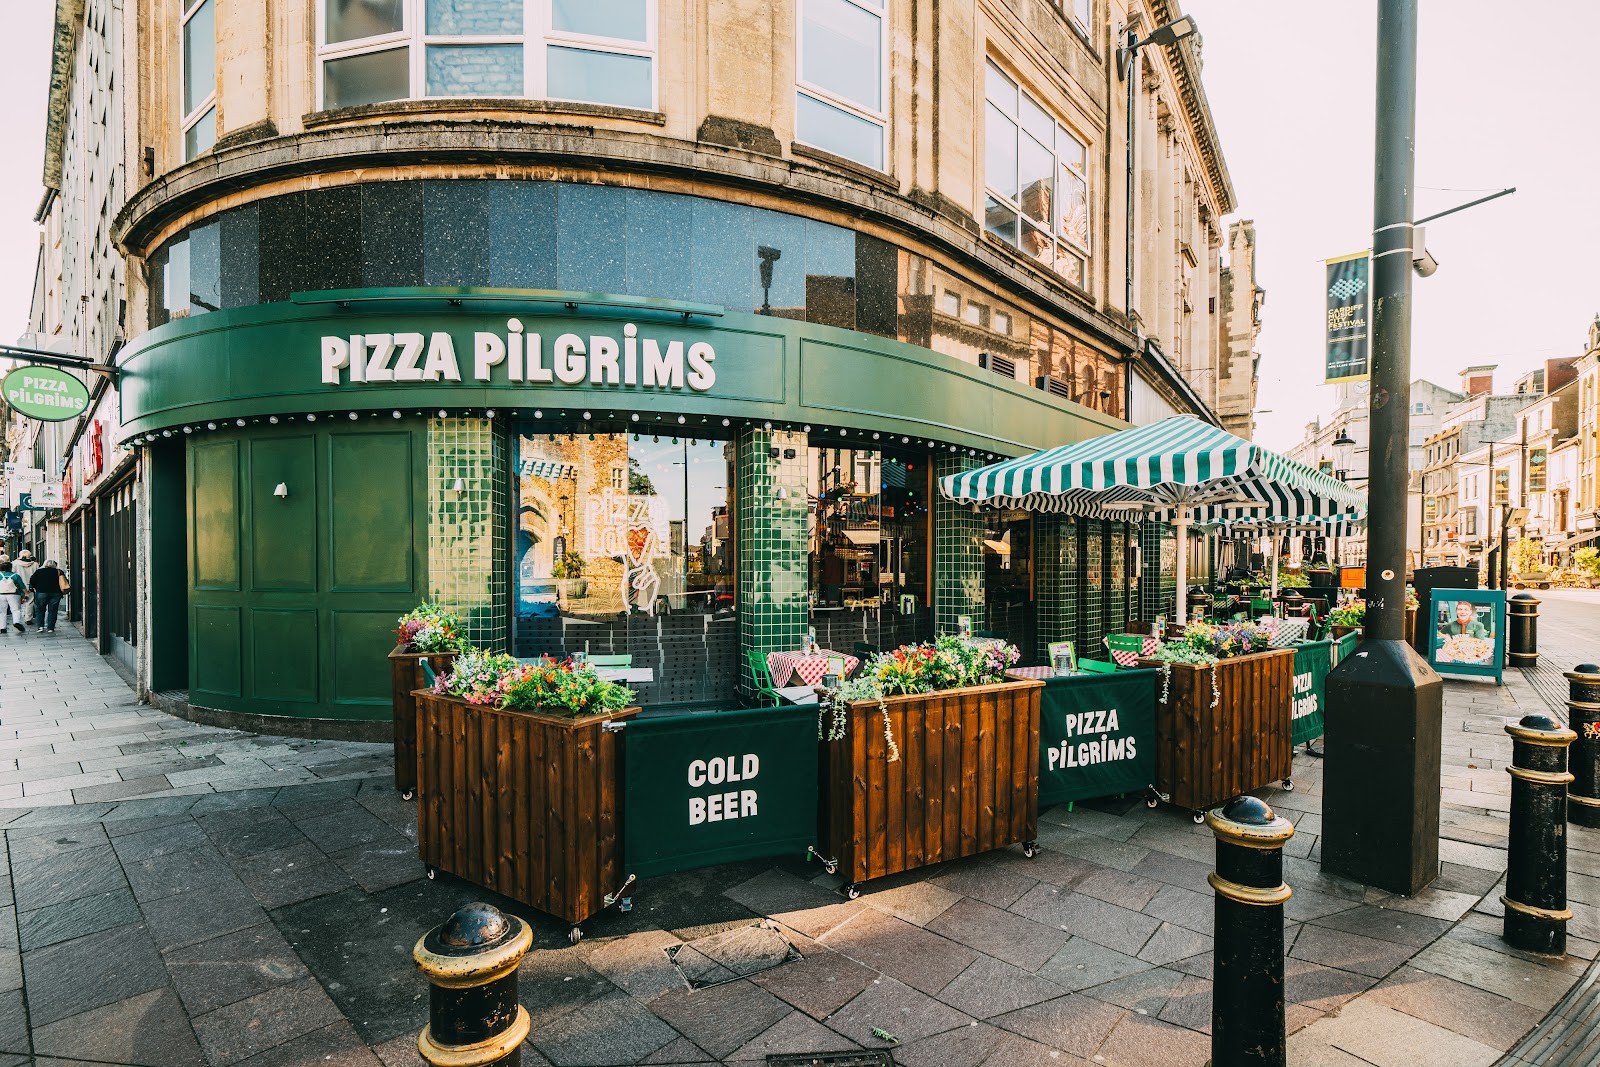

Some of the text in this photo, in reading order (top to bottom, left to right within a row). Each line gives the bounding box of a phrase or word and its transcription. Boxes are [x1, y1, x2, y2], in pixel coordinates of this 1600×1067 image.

[1328, 304, 1364, 315] CARDIFF
[1328, 311, 1353, 320] MUSIC
[1328, 319, 1366, 329] FESTIVAL
[321, 318, 716, 392] PIZZA PiLGRiMS
[23, 376, 68, 393] PIZZA
[9, 388, 84, 410] PiLGRiMS
[1293, 672, 1312, 695] PIZZA
[1291, 691, 1318, 720] iLGRiMS
[1066, 709, 1119, 737] PIZZA
[1047, 734, 1137, 771] PiLGRiMS
[688, 753, 760, 788] COLD
[688, 789, 758, 826] BEER
